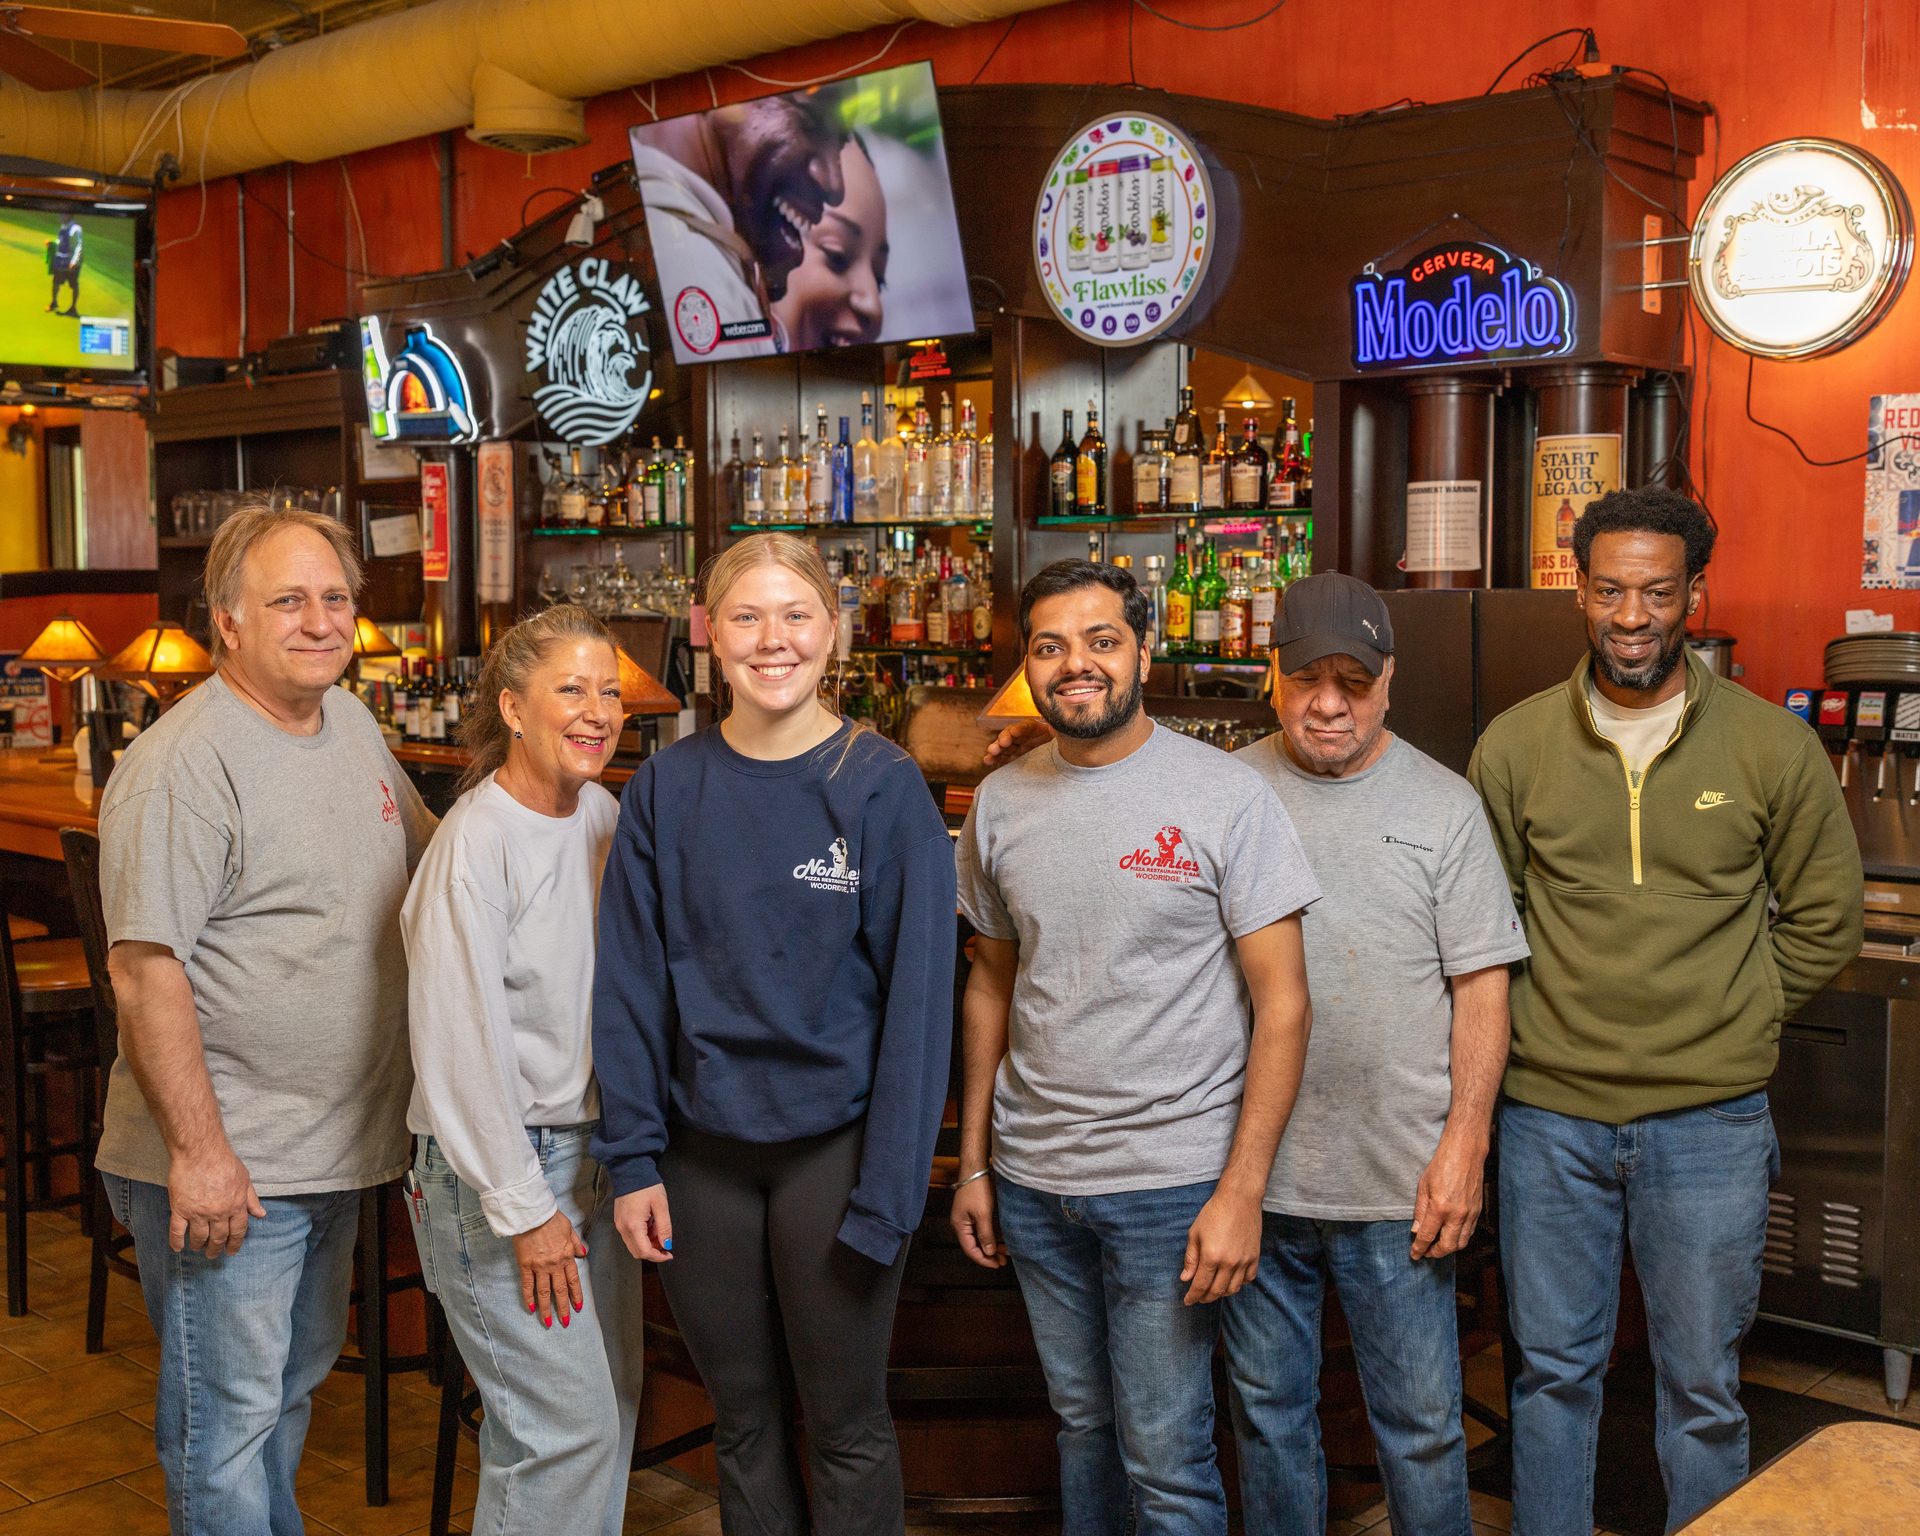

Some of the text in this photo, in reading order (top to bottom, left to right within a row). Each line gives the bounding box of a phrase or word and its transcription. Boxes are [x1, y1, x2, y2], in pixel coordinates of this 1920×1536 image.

[1411, 251, 1496, 282] CERVEZA
[1072, 274, 1167, 303] Flawliss
[525, 257, 651, 373] WHITE CLAW
[723, 323, 765, 336] weber.com
[1884, 408, 1920, 429] RED
[1541, 452, 1599, 468] START
[1544, 467, 1593, 481] YOUR
[1445, 485, 1478, 493] WARNING
[1537, 481, 1605, 497] LEGACY
[1560, 554, 1578, 569] BA
[1540, 572, 1578, 586] BOTTL
[1701, 790, 1726, 803] NIKE
[1381, 835, 1434, 852] Champion
[1119, 849, 1200, 872] Nonnies
[1146, 867, 1182, 875] RESTAURANT
